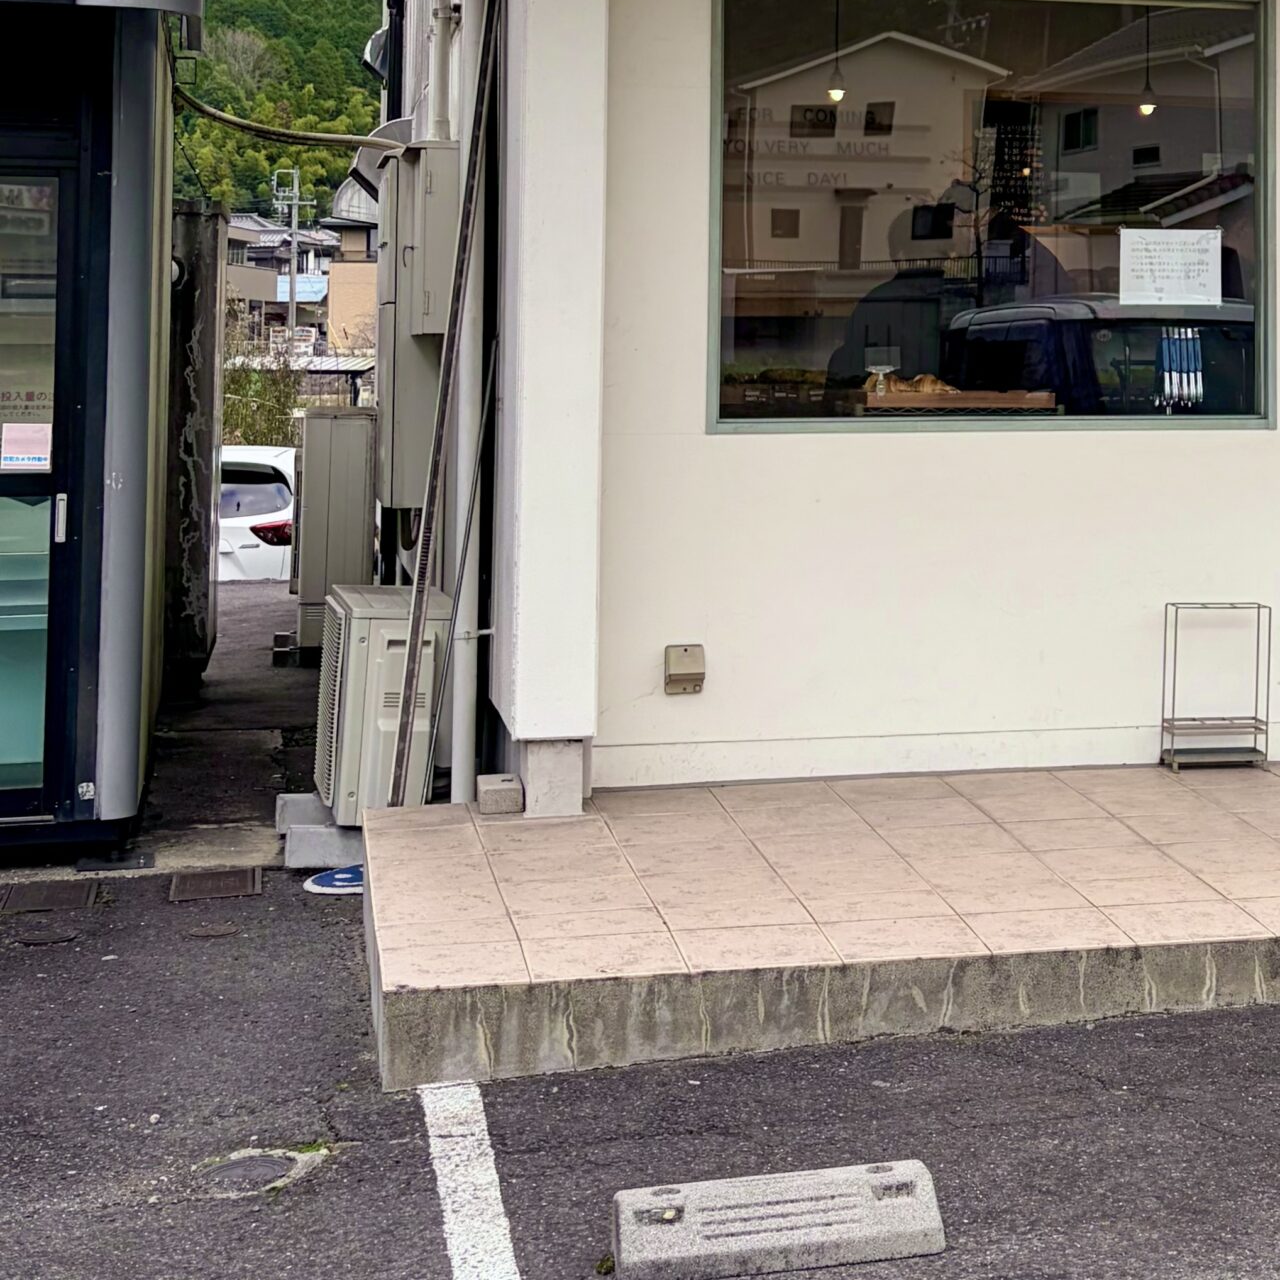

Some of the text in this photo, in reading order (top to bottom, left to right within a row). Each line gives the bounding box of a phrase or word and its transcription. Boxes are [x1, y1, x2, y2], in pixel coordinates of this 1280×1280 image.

[803, 107, 877, 123] COMING
[764, 140, 809, 154] VERY
[837, 141, 890, 155] MUCH
[807, 172, 848, 186] DAY!
